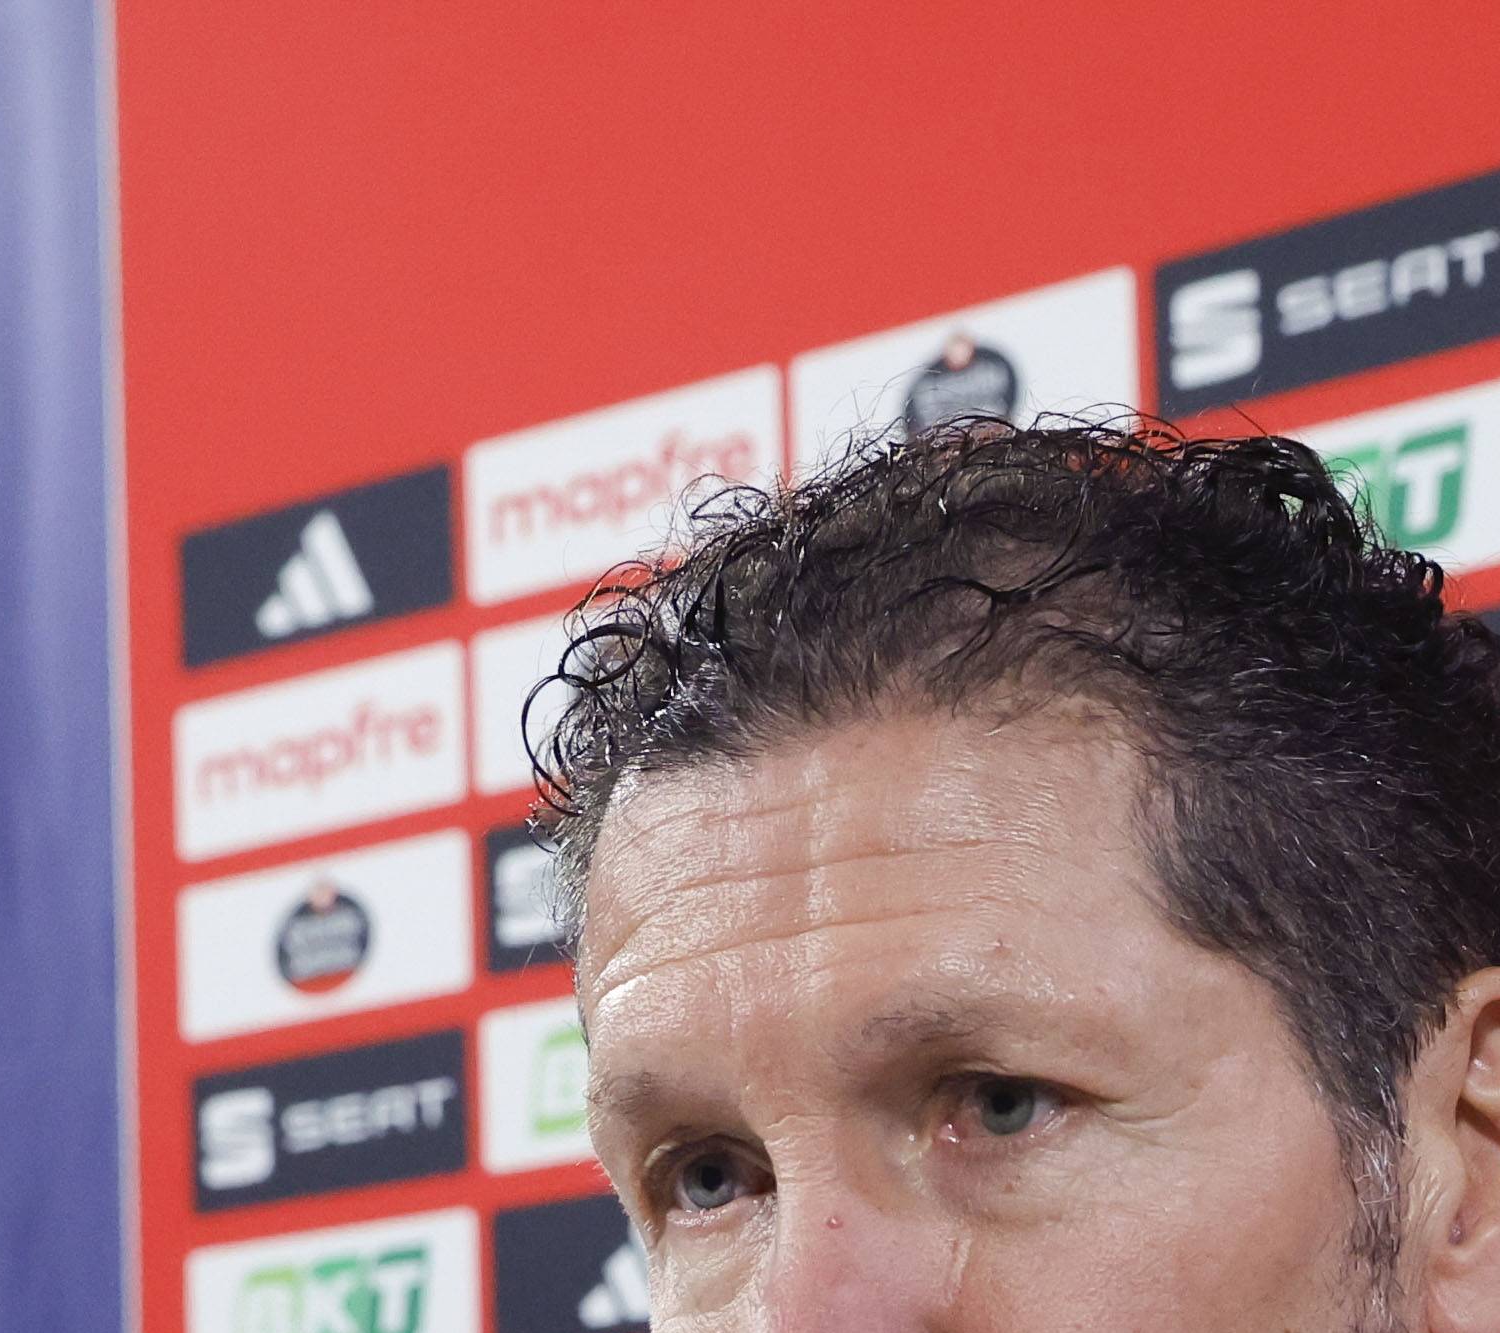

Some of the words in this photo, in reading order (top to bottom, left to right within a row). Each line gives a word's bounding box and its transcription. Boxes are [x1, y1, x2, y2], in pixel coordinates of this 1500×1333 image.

[1278, 230, 1498, 334] SEAT
[199, 702, 442, 799] mapfre
[280, 1078, 453, 1154] SEAT
